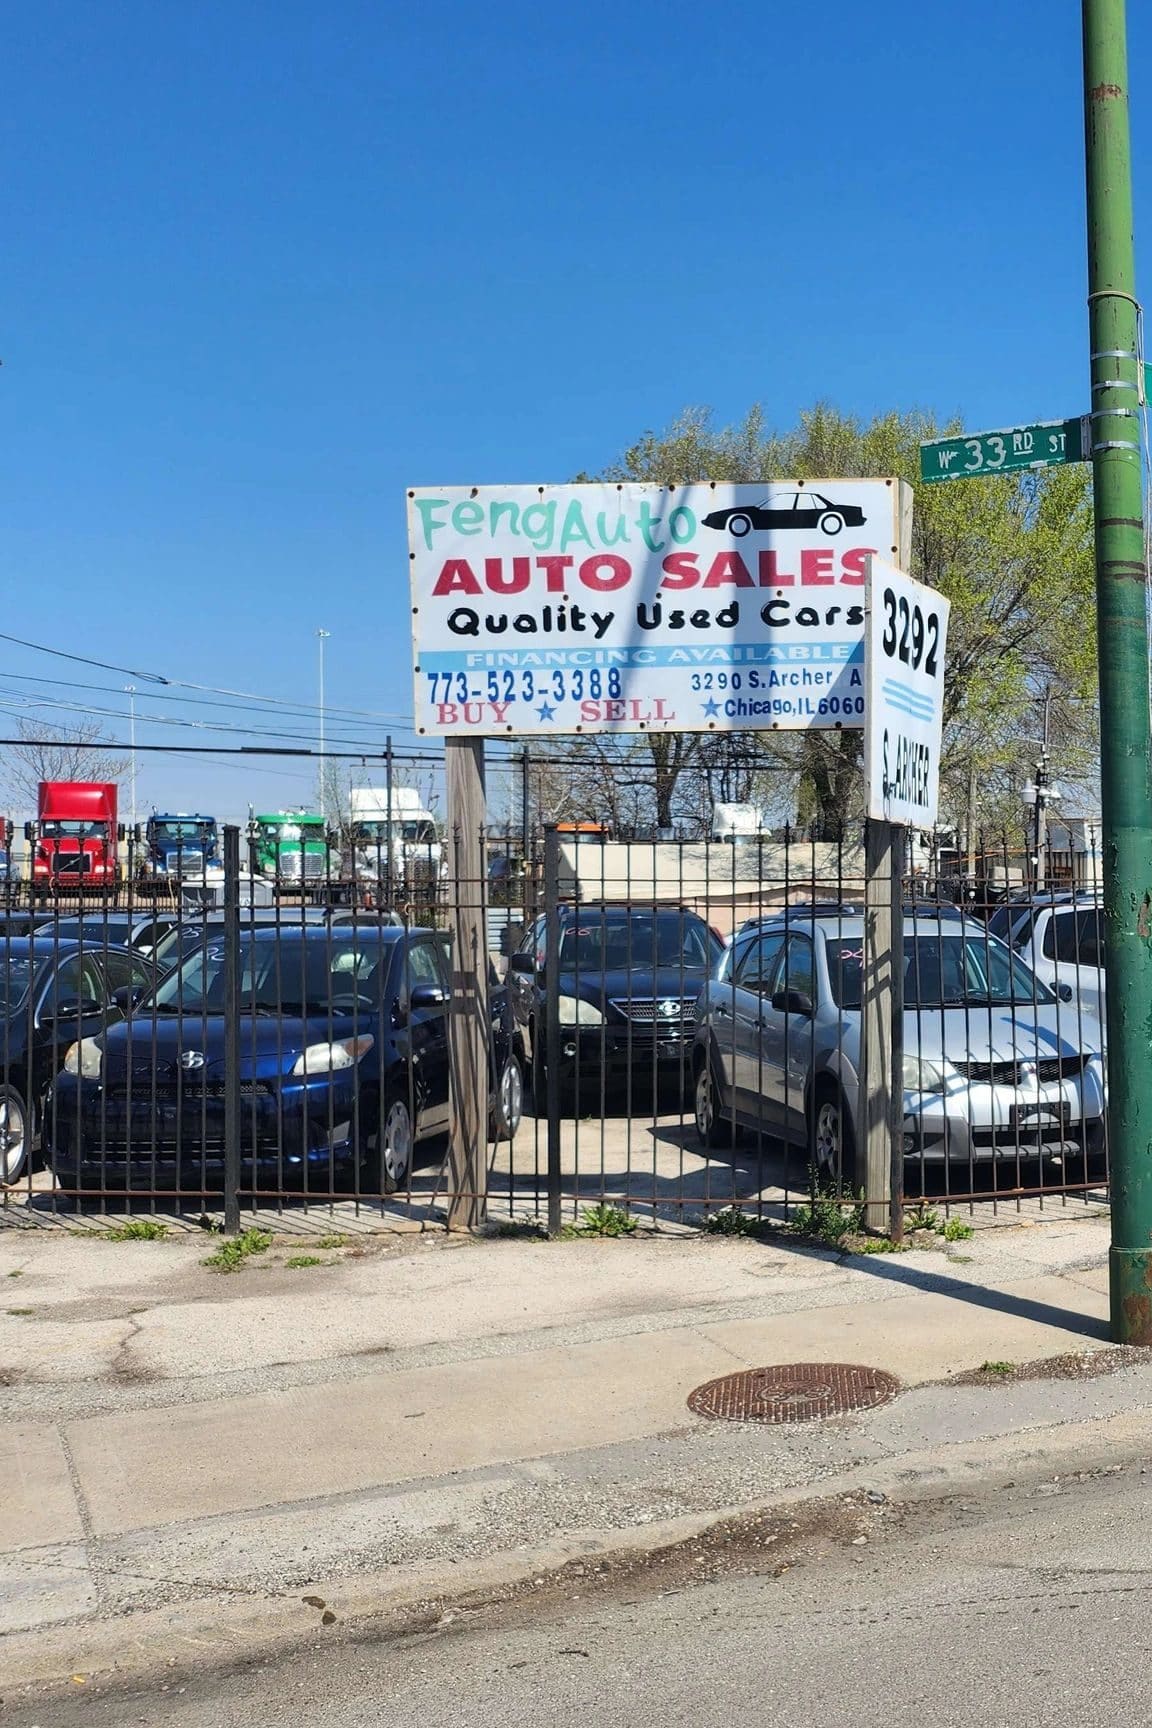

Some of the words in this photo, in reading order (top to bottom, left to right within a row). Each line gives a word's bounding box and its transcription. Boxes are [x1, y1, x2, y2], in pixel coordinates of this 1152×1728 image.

[1048, 433, 1066, 453] ST
[432, 553, 632, 597] AUTO
[660, 548, 878, 591] SALES
[447, 604, 615, 639] Quality
[636, 600, 740, 630] Used
[760, 599, 864, 628] Cars
[882, 586, 939, 678] 3292
[466, 649, 657, 667] FINANCING
[667, 645, 849, 663] AVAILABLE
[427, 667, 621, 704] 773-523-3388
[691, 671, 742, 691] 3290
[436, 701, 513, 725] BUY
[580, 698, 676, 722] SELL
